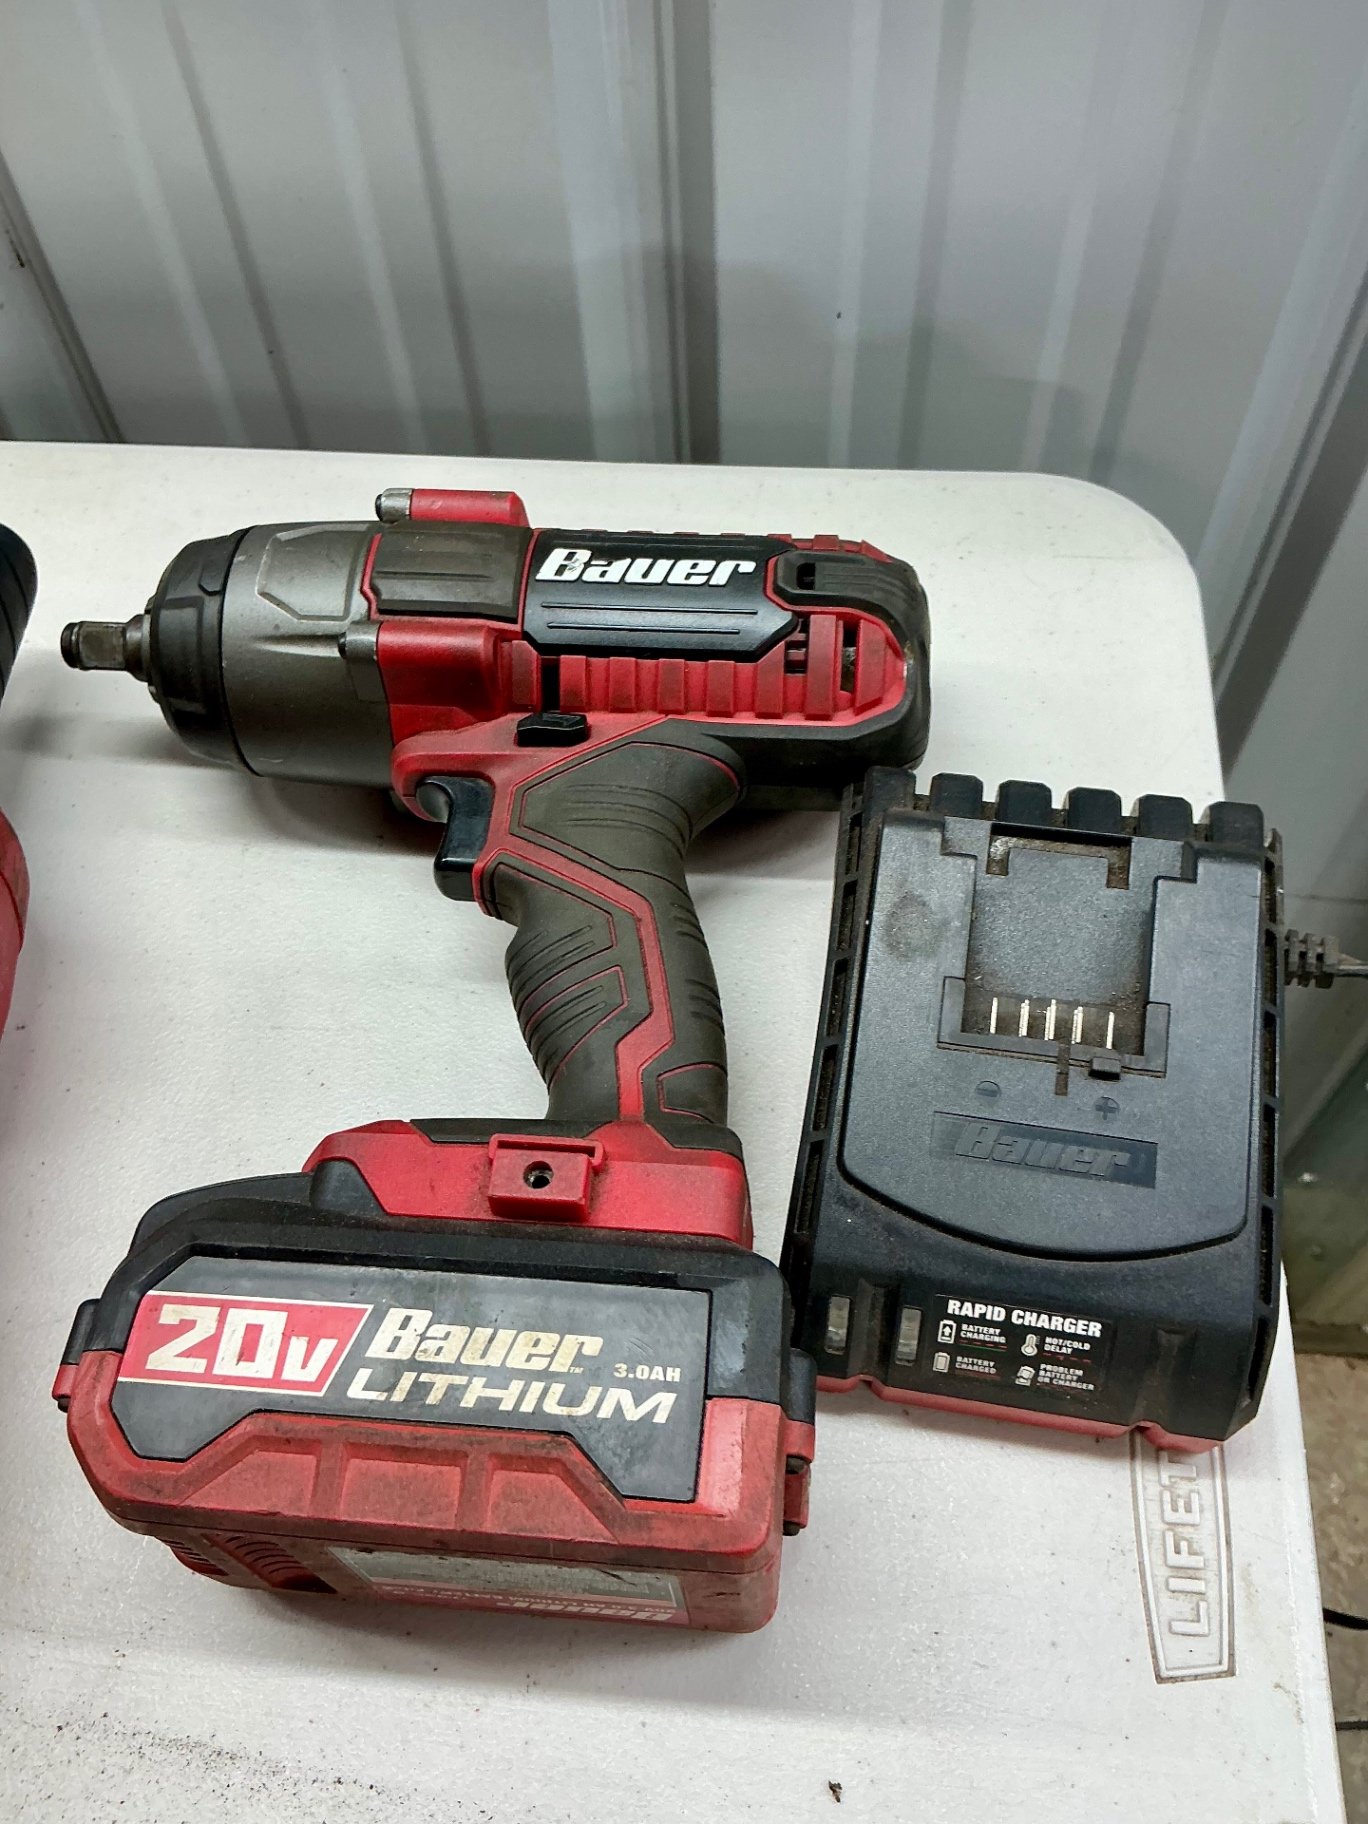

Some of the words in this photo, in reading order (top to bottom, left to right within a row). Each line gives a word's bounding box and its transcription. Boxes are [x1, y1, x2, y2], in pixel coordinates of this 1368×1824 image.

[535, 548, 756, 587] Bauer
[954, 1121, 1131, 1177] Bauer
[947, 1299, 1006, 1322] RAPID
[1011, 1309, 1102, 1338] CHARGER
[961, 1323, 1002, 1336] BATTERY
[364, 1307, 603, 1373] Bauer
[960, 1331, 1007, 1344] CHARGING
[1045, 1336, 1091, 1351] HOT/COLD
[1044, 1344, 1073, 1355] DELAY
[955, 1362, 997, 1374] CHARGED
[956, 1356, 996, 1368] BATTERY
[613, 1363, 682, 1382] 3.0AH
[1039, 1370, 1078, 1381] BATTERY
[1040, 1363, 1084, 1377] PROBLEM
[1037, 1376, 1051, 1384] OR
[1052, 1379, 1095, 1391] CHARGER
[346, 1368, 677, 1424] LITHIUM
